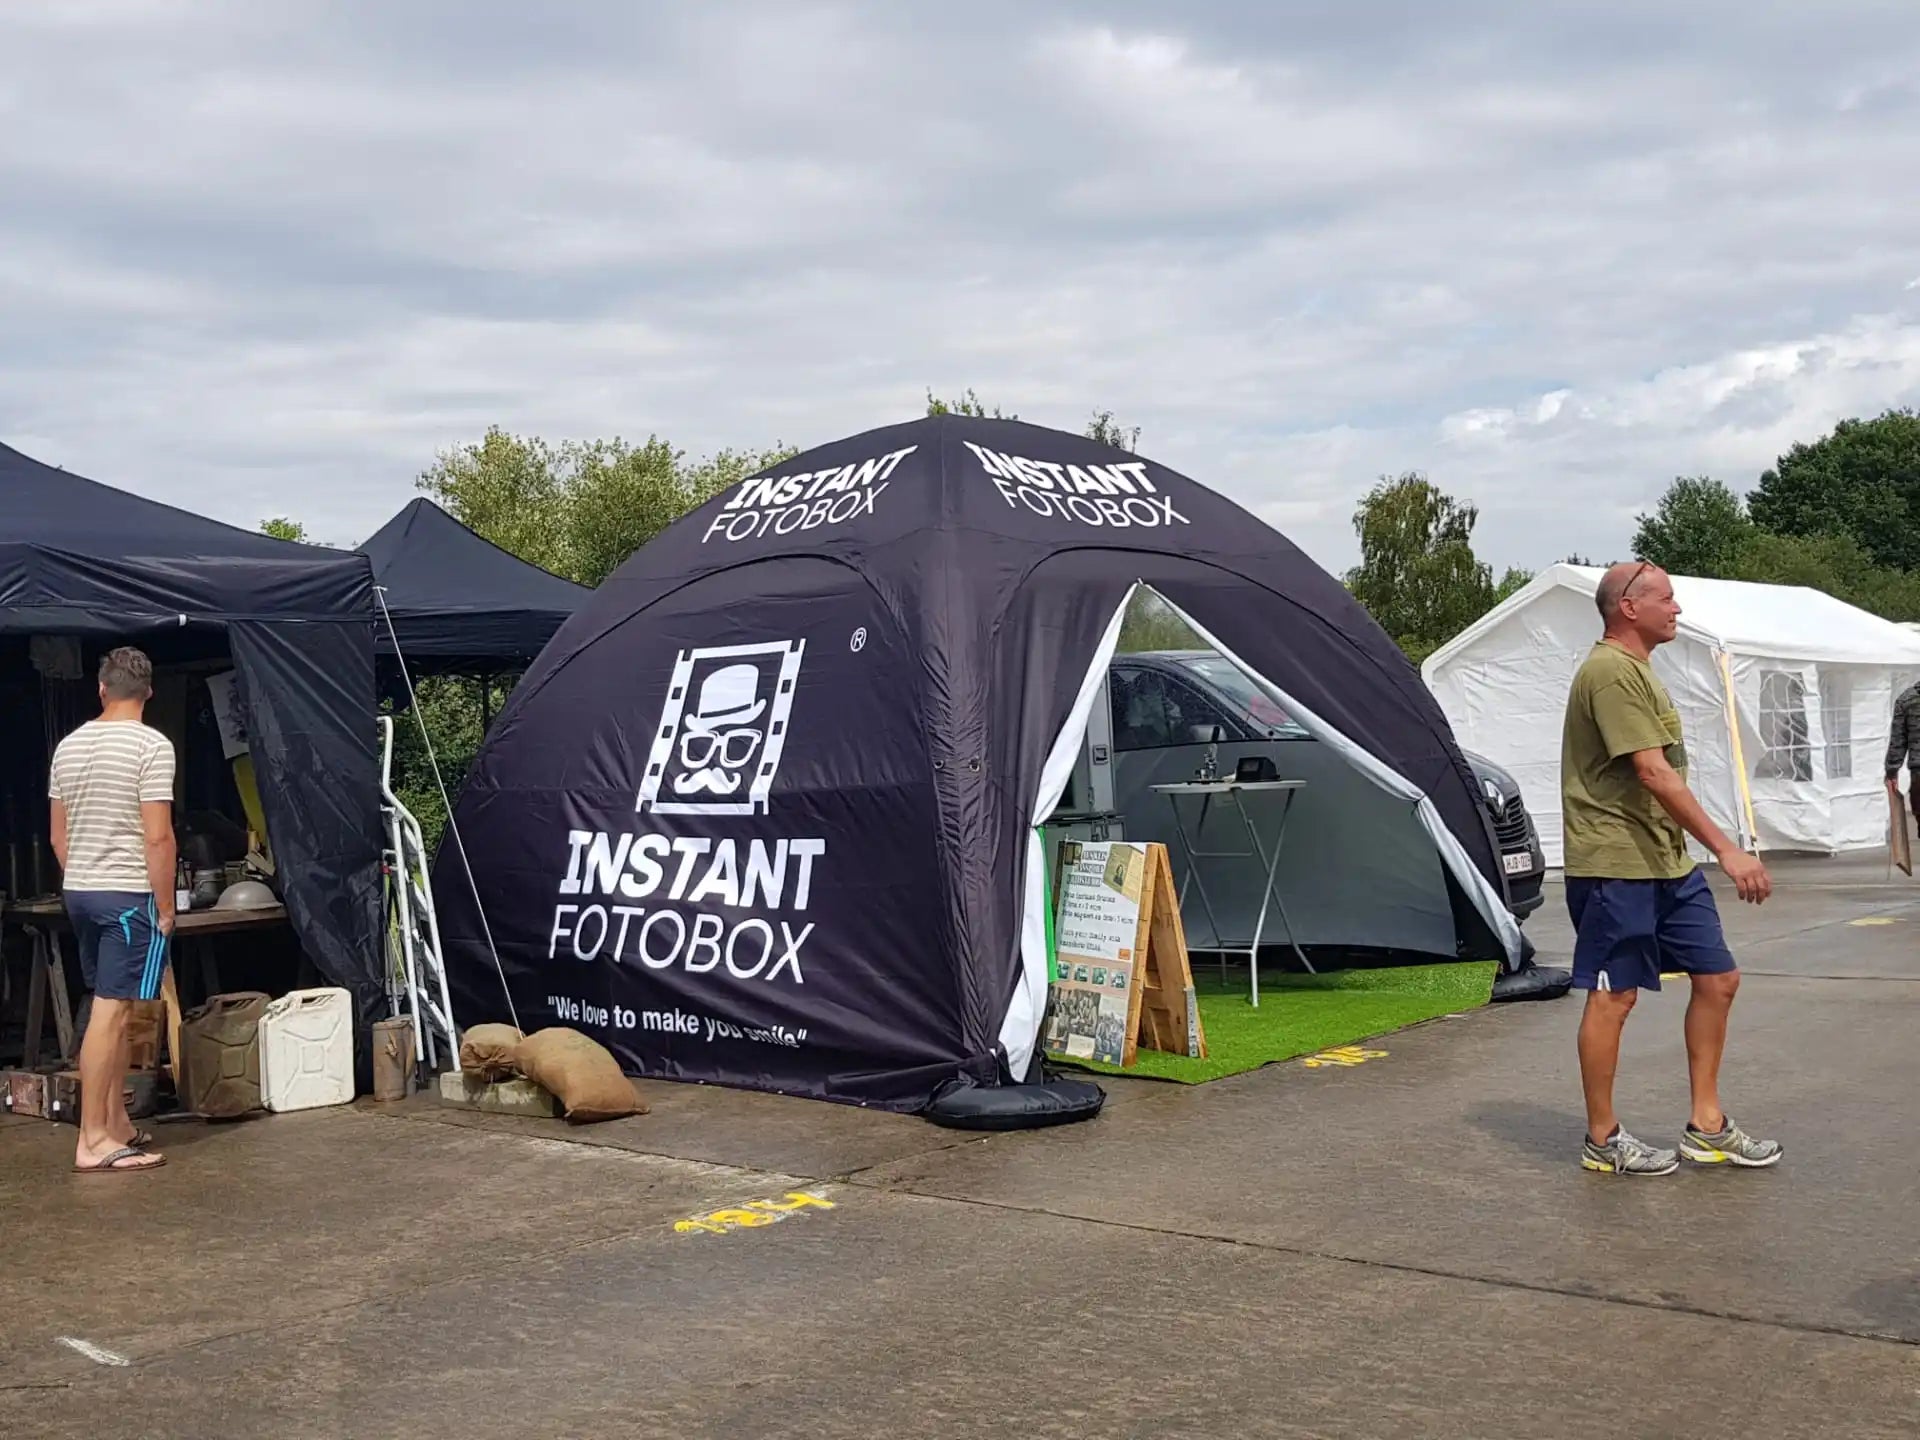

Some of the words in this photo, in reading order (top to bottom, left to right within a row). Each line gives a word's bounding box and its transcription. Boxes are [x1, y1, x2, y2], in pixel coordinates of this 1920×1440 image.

[723, 444, 918, 510] INSTANT
[963, 440, 1157, 495] INSTANT
[701, 481, 889, 544] FOTOBOX
[991, 477, 1191, 528] FOTOBOX
[559, 829, 826, 910] INSTANT
[548, 904, 815, 984] FOTOBOX
[548, 995, 579, 1022] "We
[582, 999, 608, 1027] love
[613, 1004, 636, 1030] to
[642, 1007, 700, 1034] make
[704, 1016, 744, 1042] you
